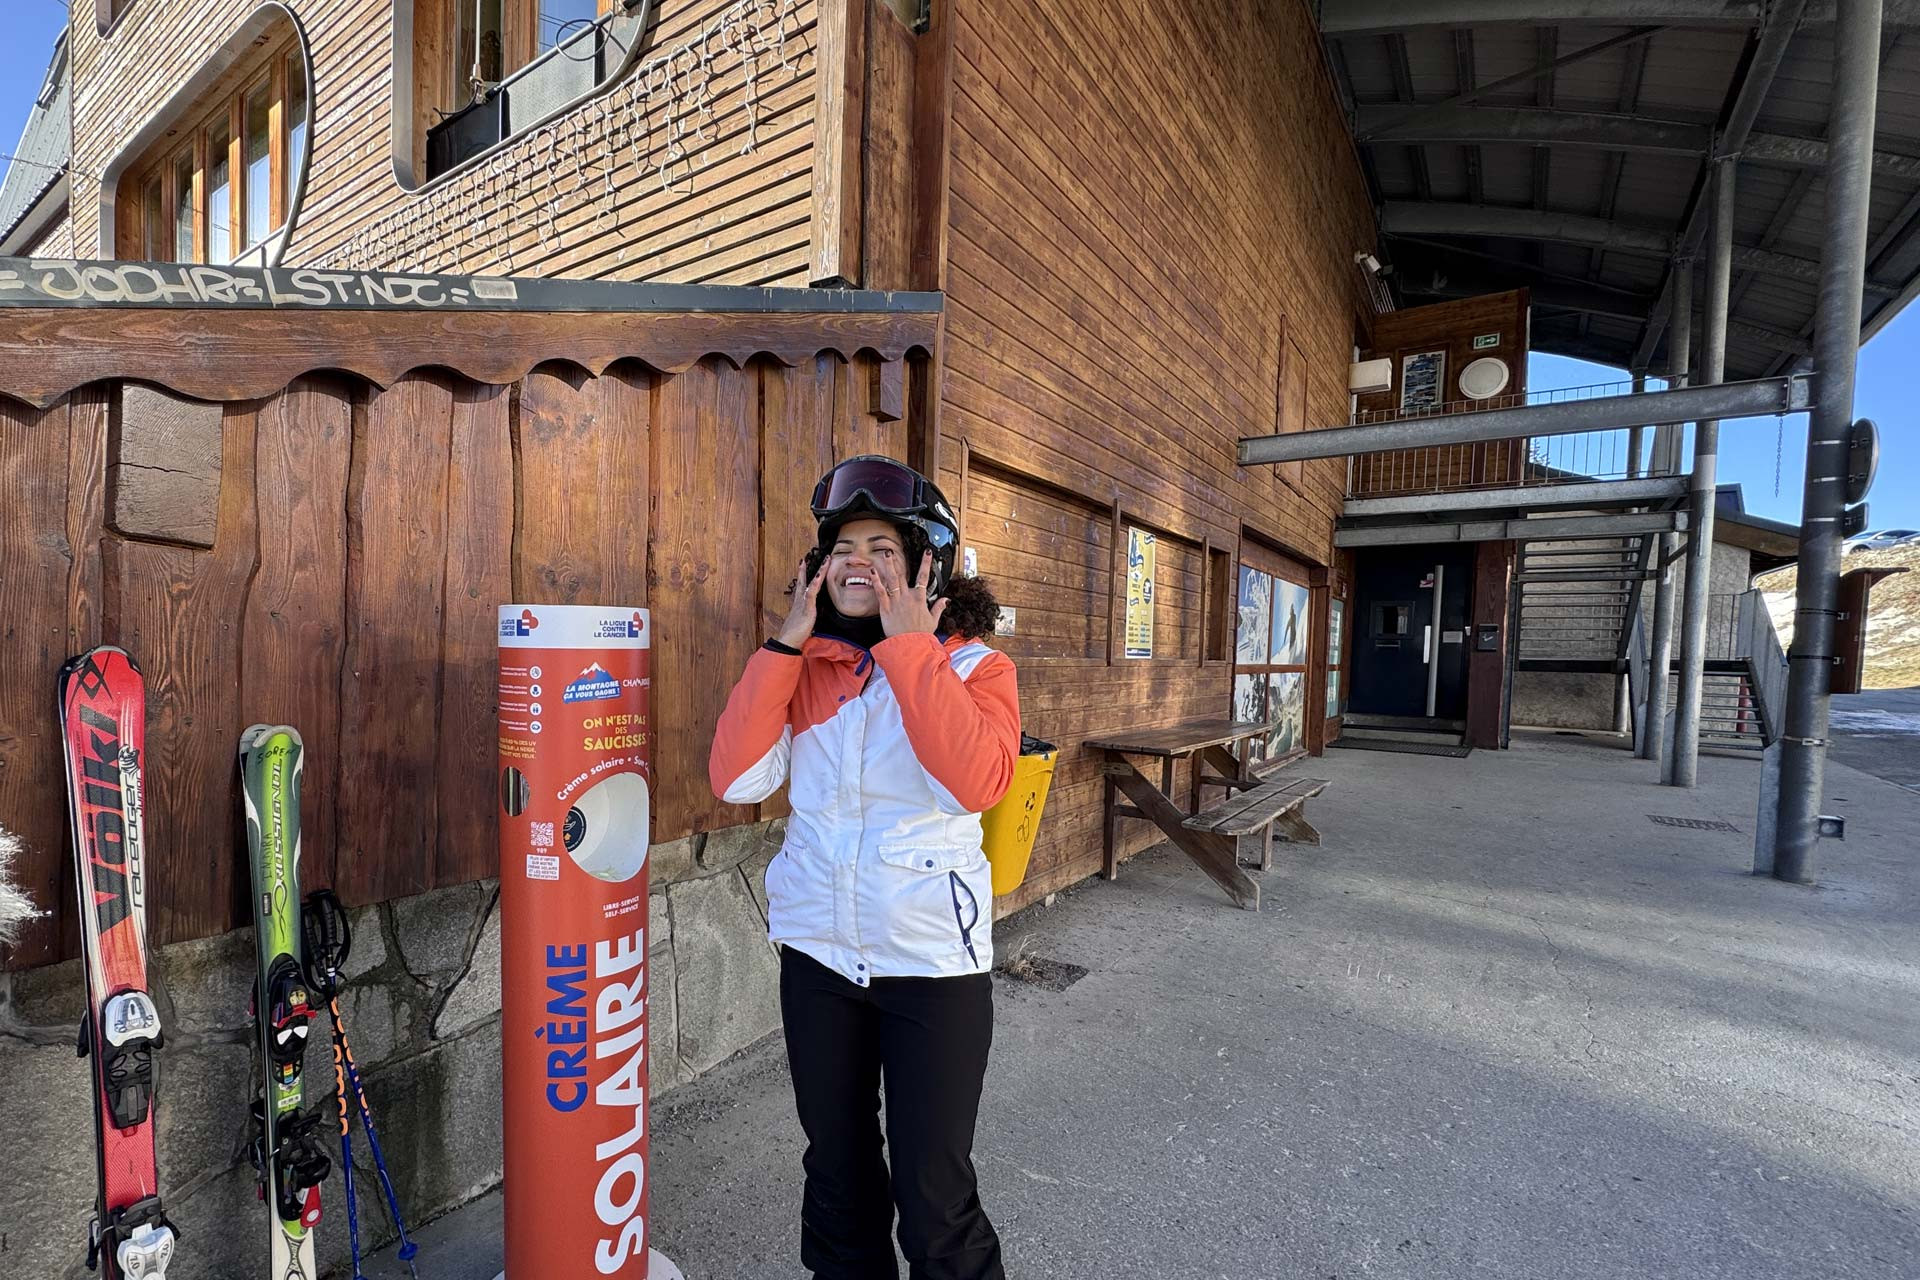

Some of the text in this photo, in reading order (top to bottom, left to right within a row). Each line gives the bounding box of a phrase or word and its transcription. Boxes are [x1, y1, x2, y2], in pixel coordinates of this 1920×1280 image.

[565, 679, 620, 693] LA MONTAGNE
[575, 690, 593, 699] VOUS
[594, 688, 616, 697] GAGNE
[582, 713, 646, 730] ON N'EST PAS
[615, 726, 628, 734] DES
[556, 772, 588, 801] Crème
[590, 757, 624, 775] solaire
[270, 759, 286, 880] ROSSIGNOL
[602, 895, 640, 911] LIBRE-SERVICE
[604, 903, 639, 918] SELF-SERVICE
[535, 944, 588, 1112] CRÈME
[594, 928, 644, 1275] SOLAIRE
